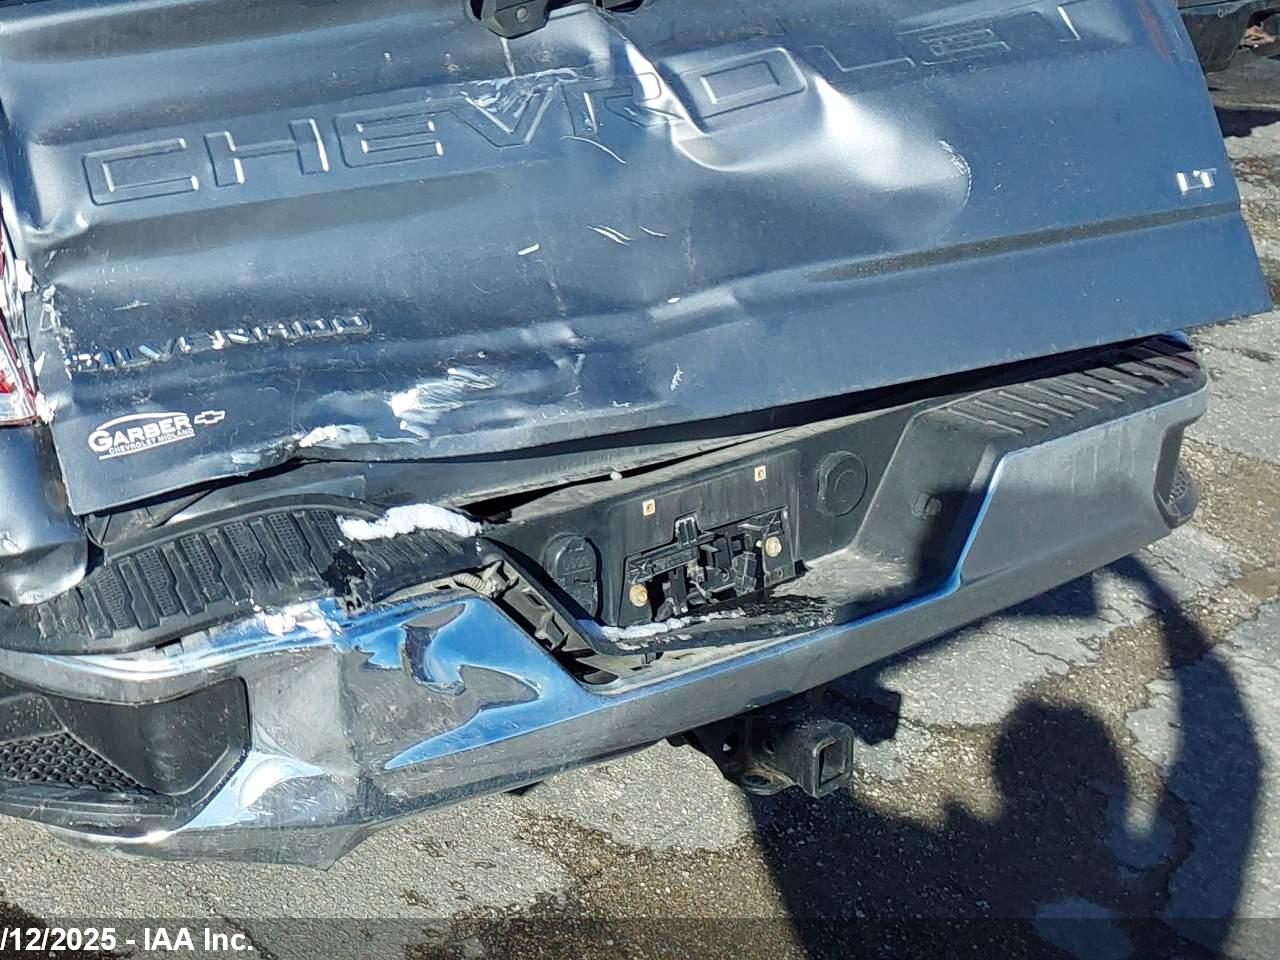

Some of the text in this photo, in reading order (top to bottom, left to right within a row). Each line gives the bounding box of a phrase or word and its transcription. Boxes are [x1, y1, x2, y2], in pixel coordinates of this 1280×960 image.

[1176, 167, 1218, 194] LT
[88, 415, 193, 453] GARBER
[108, 427, 195, 455] CHEVROLET MIDLAND
